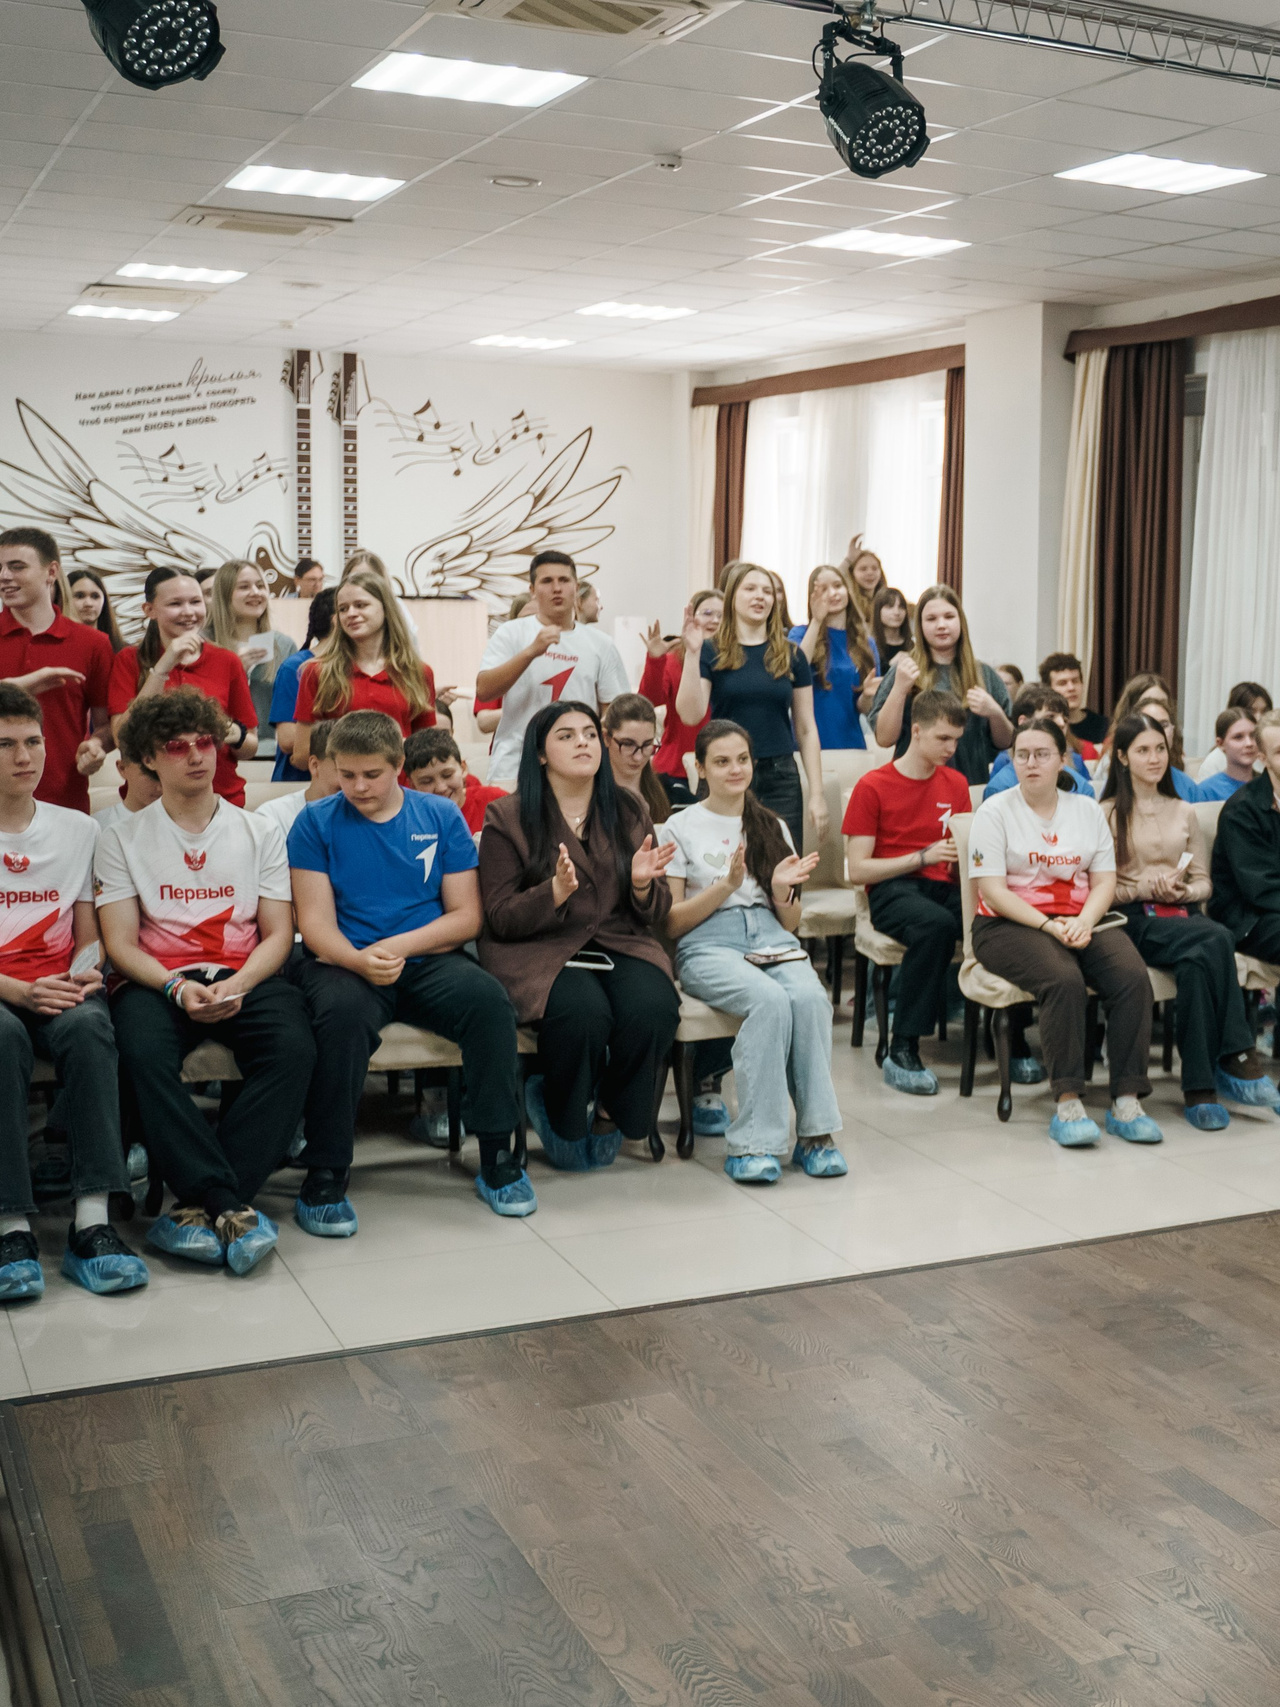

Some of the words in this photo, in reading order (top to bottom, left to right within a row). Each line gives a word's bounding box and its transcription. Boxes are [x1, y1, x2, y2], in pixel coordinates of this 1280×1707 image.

[545, 650, 579, 663] ервые
[1029, 851, 1082, 868] Первые
[160, 883, 236, 904] Первые
